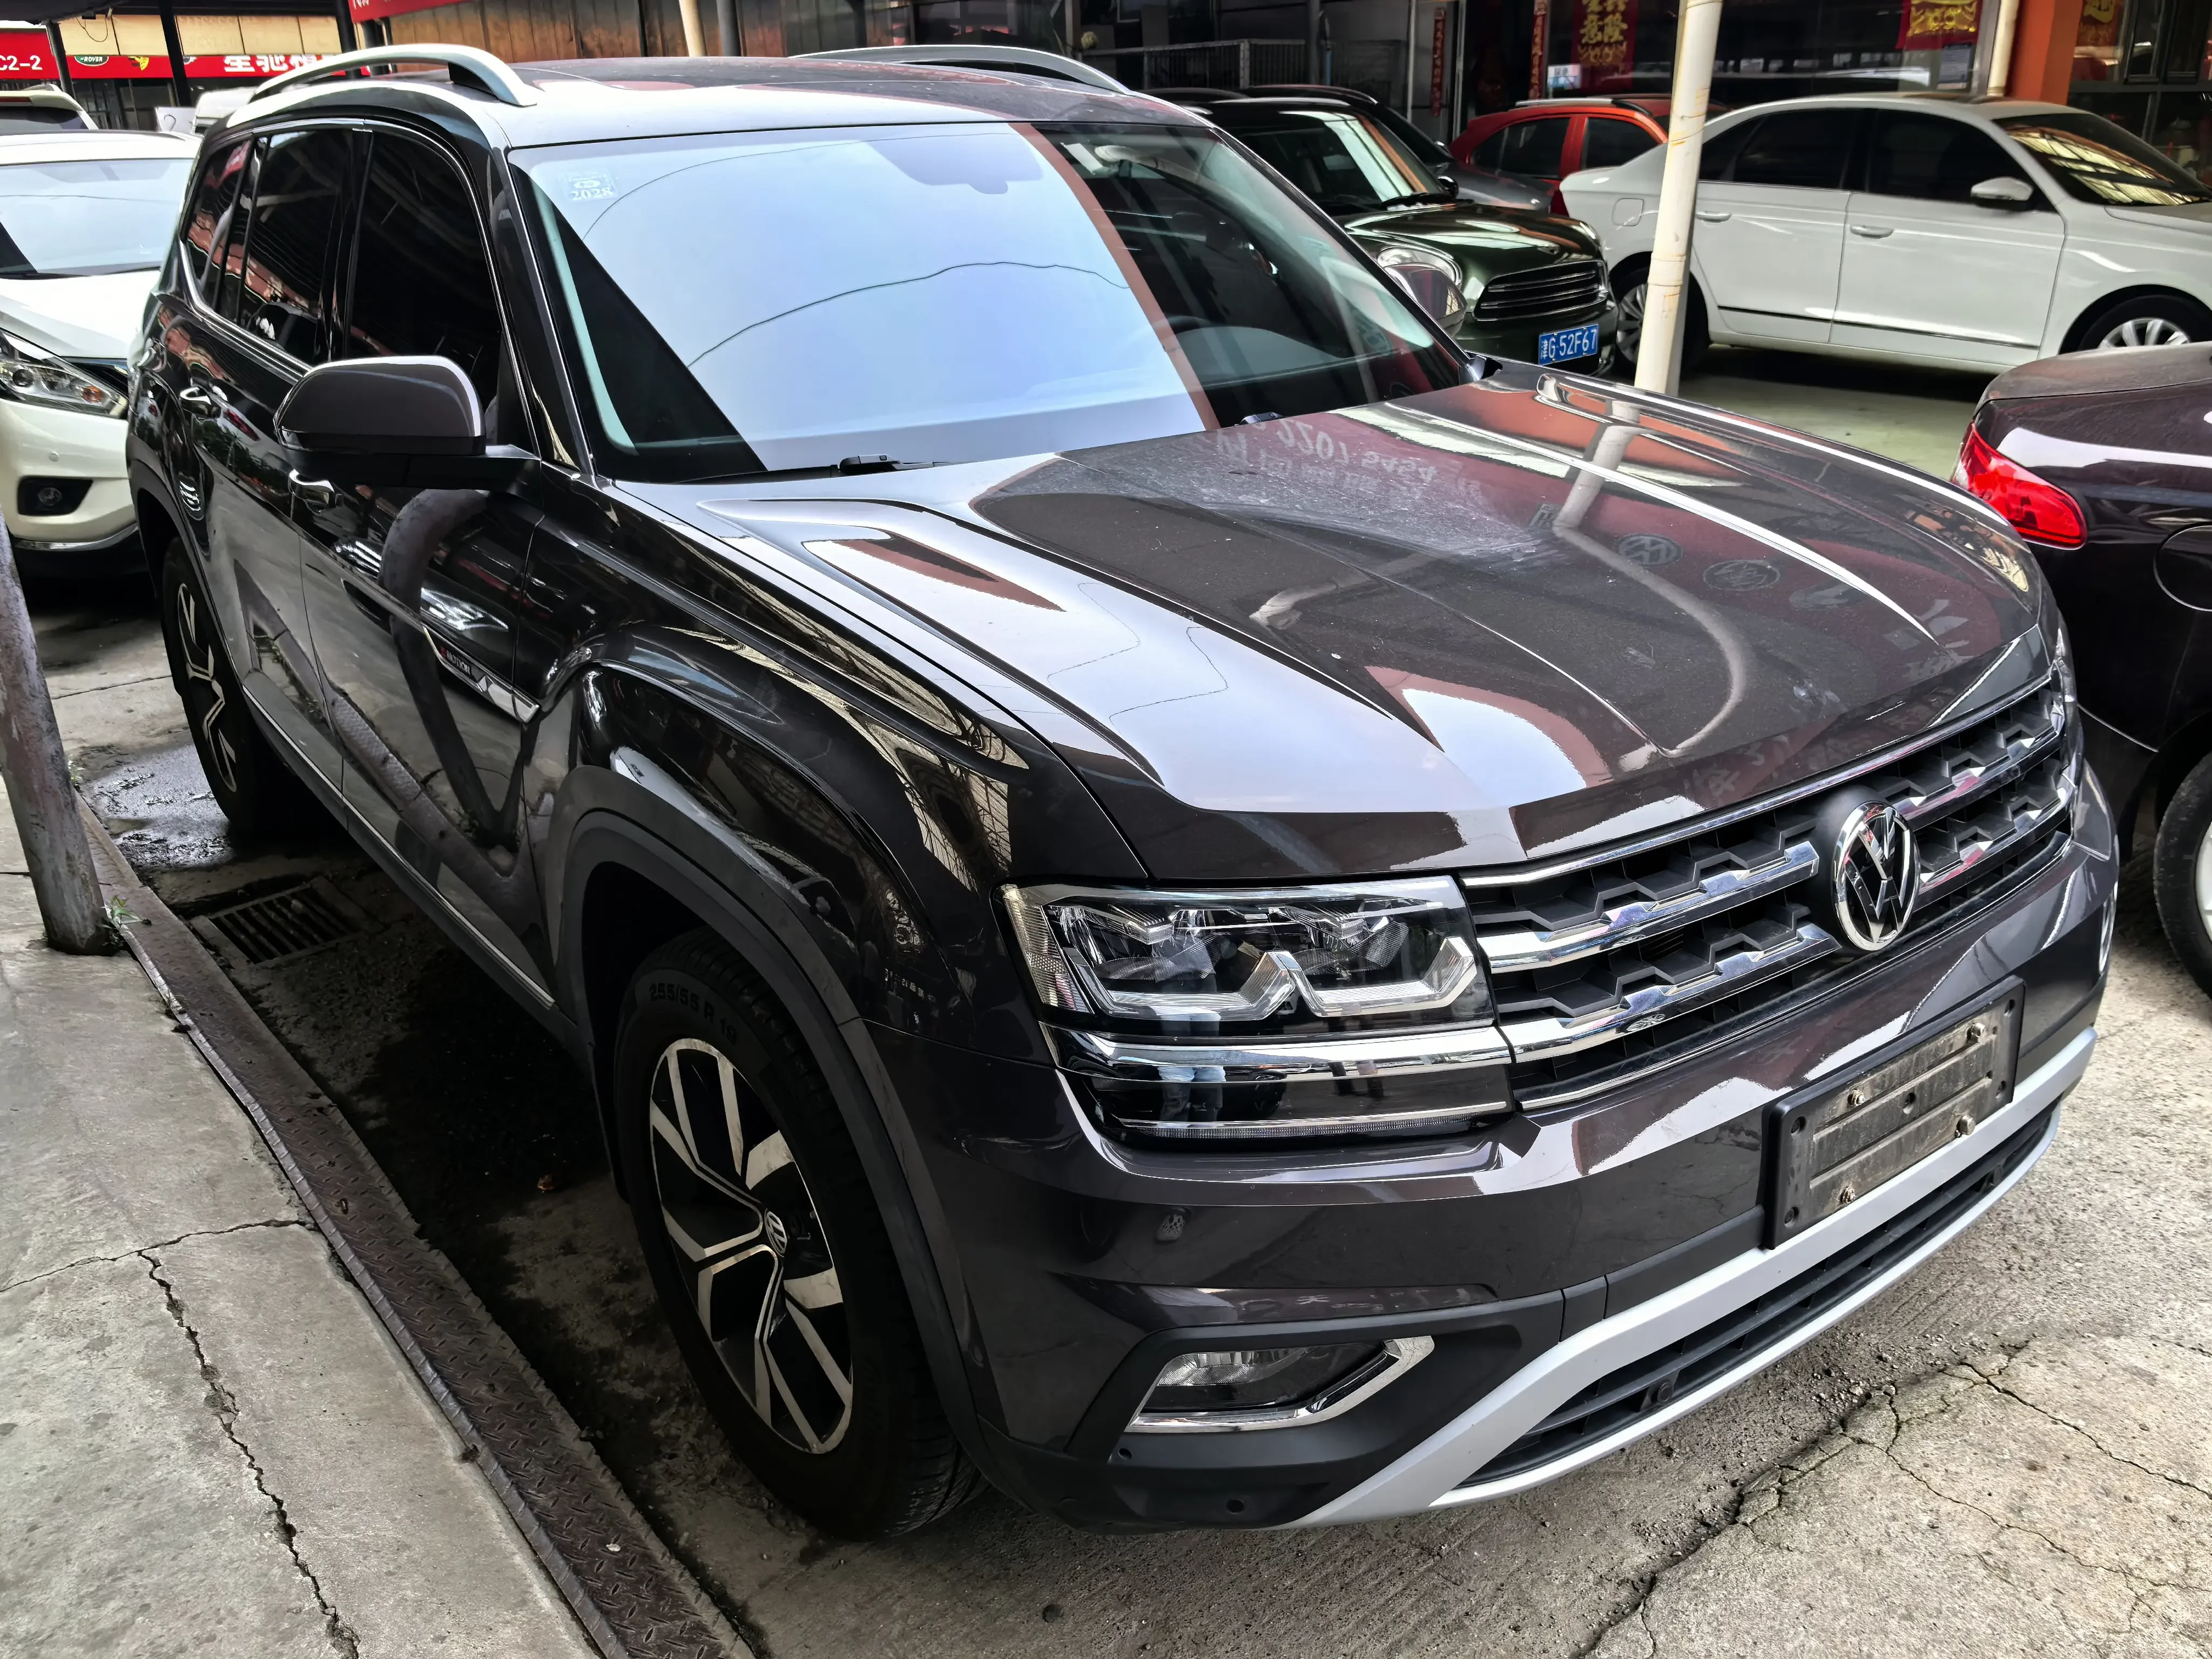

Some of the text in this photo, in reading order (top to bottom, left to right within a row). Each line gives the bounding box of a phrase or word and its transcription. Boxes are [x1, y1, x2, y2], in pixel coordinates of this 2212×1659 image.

[571, 187, 613, 201] 2028
[649, 982, 699, 1012] 255/55
[704, 1000, 715, 1024] R
